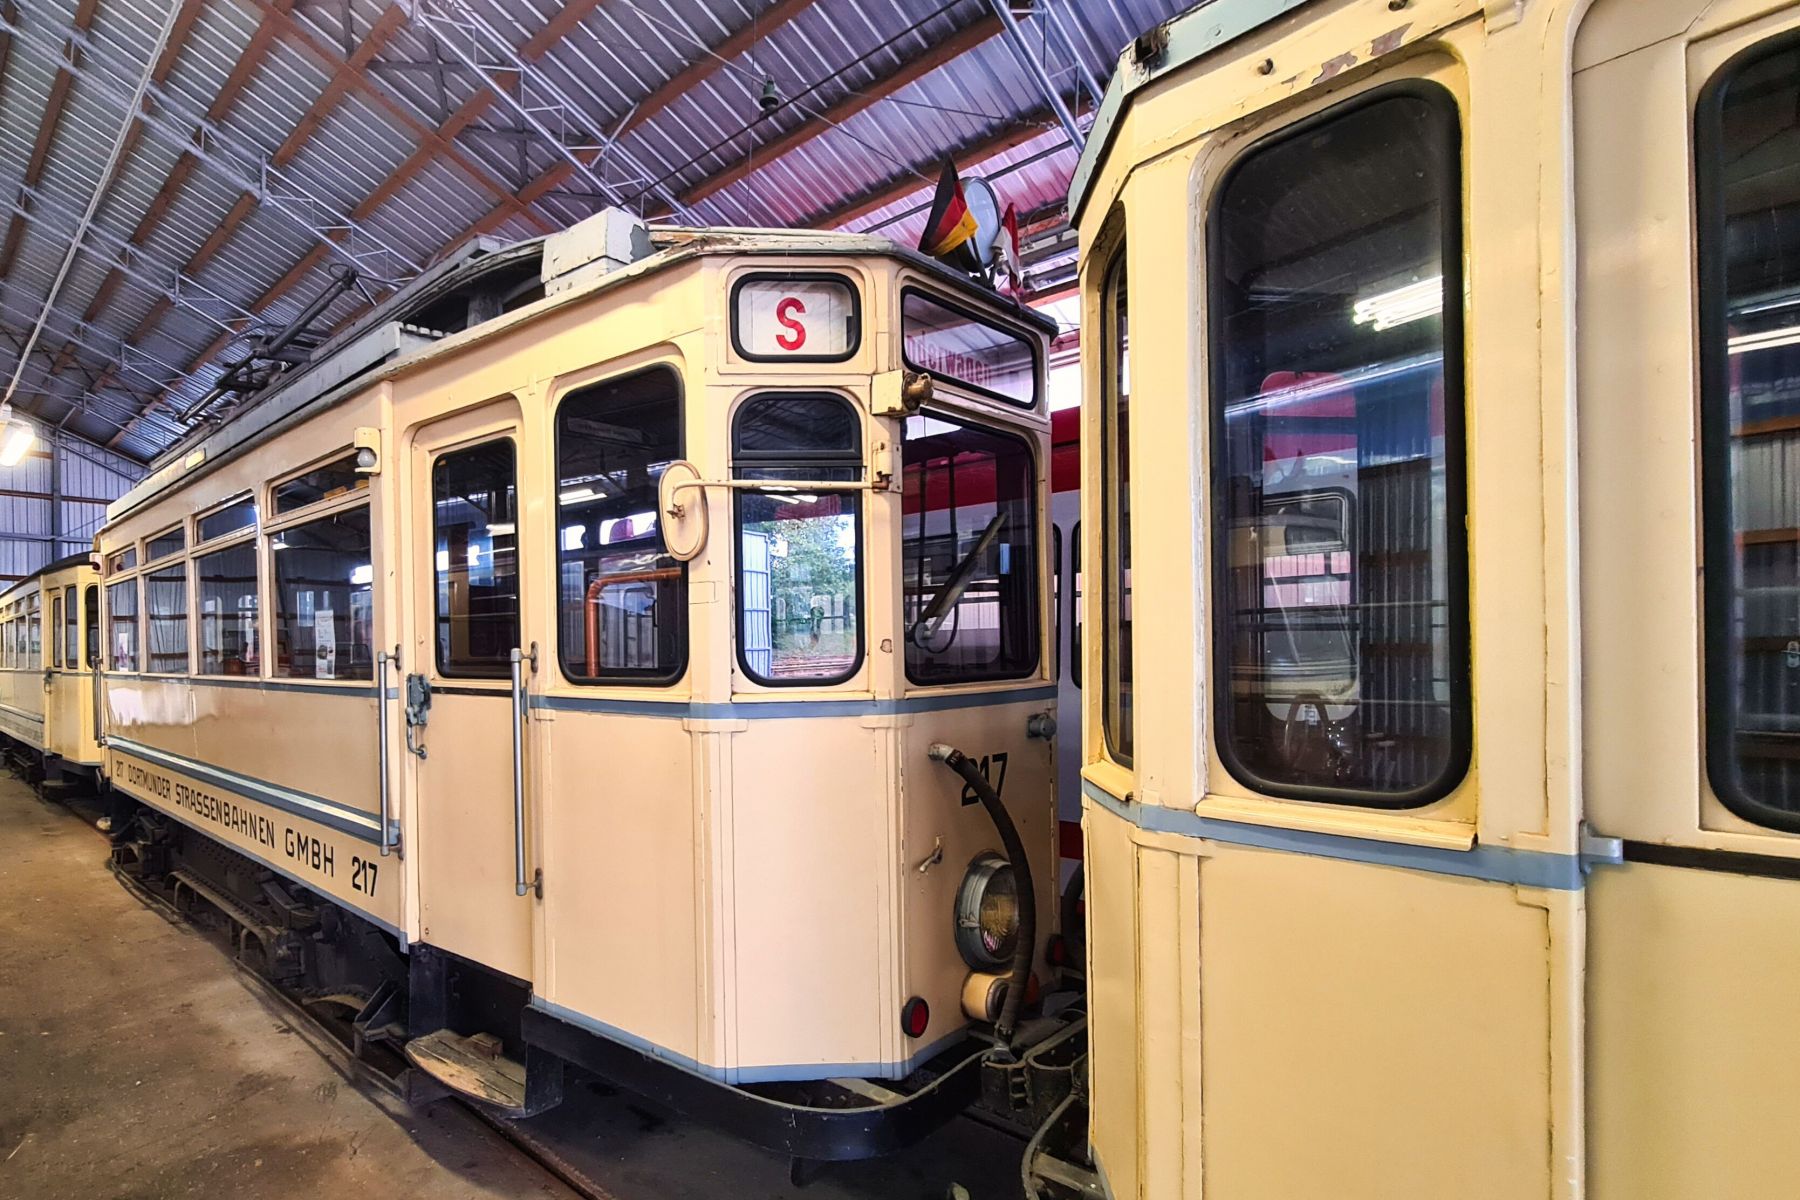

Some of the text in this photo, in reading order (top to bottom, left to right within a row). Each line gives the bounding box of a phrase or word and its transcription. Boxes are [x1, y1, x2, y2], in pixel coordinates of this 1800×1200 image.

[776, 297, 806, 350] S
[128, 764, 171, 800] DORTMUNDER
[176, 783, 275, 848] STRASSENBAHNEN
[285, 828, 334, 877] GMBH
[352, 856, 378, 897] 217
